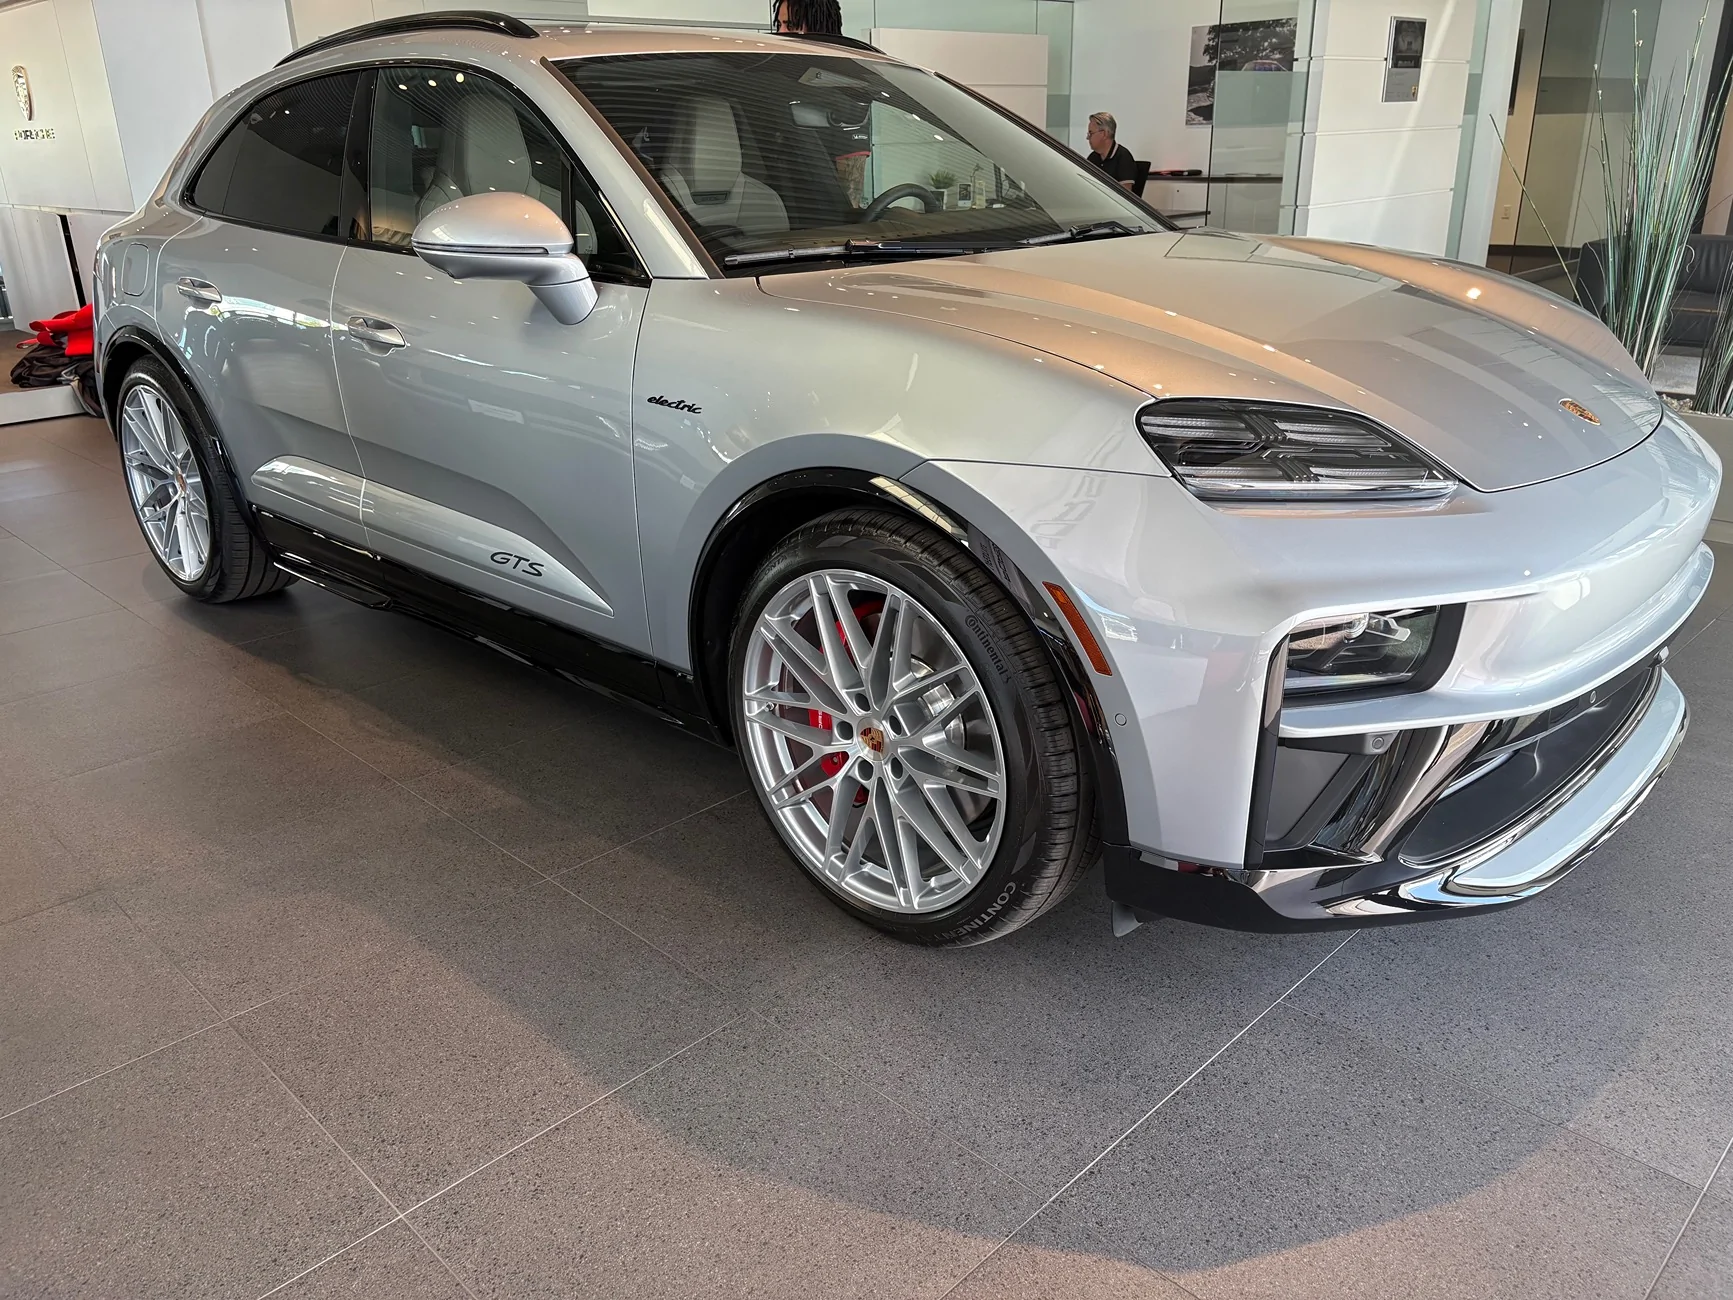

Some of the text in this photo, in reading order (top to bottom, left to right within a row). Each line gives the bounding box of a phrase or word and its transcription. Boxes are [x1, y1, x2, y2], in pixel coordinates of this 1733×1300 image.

[647, 395, 702, 414] electric
[490, 551, 545, 577] GTS
[964, 614, 1009, 676] Continental
